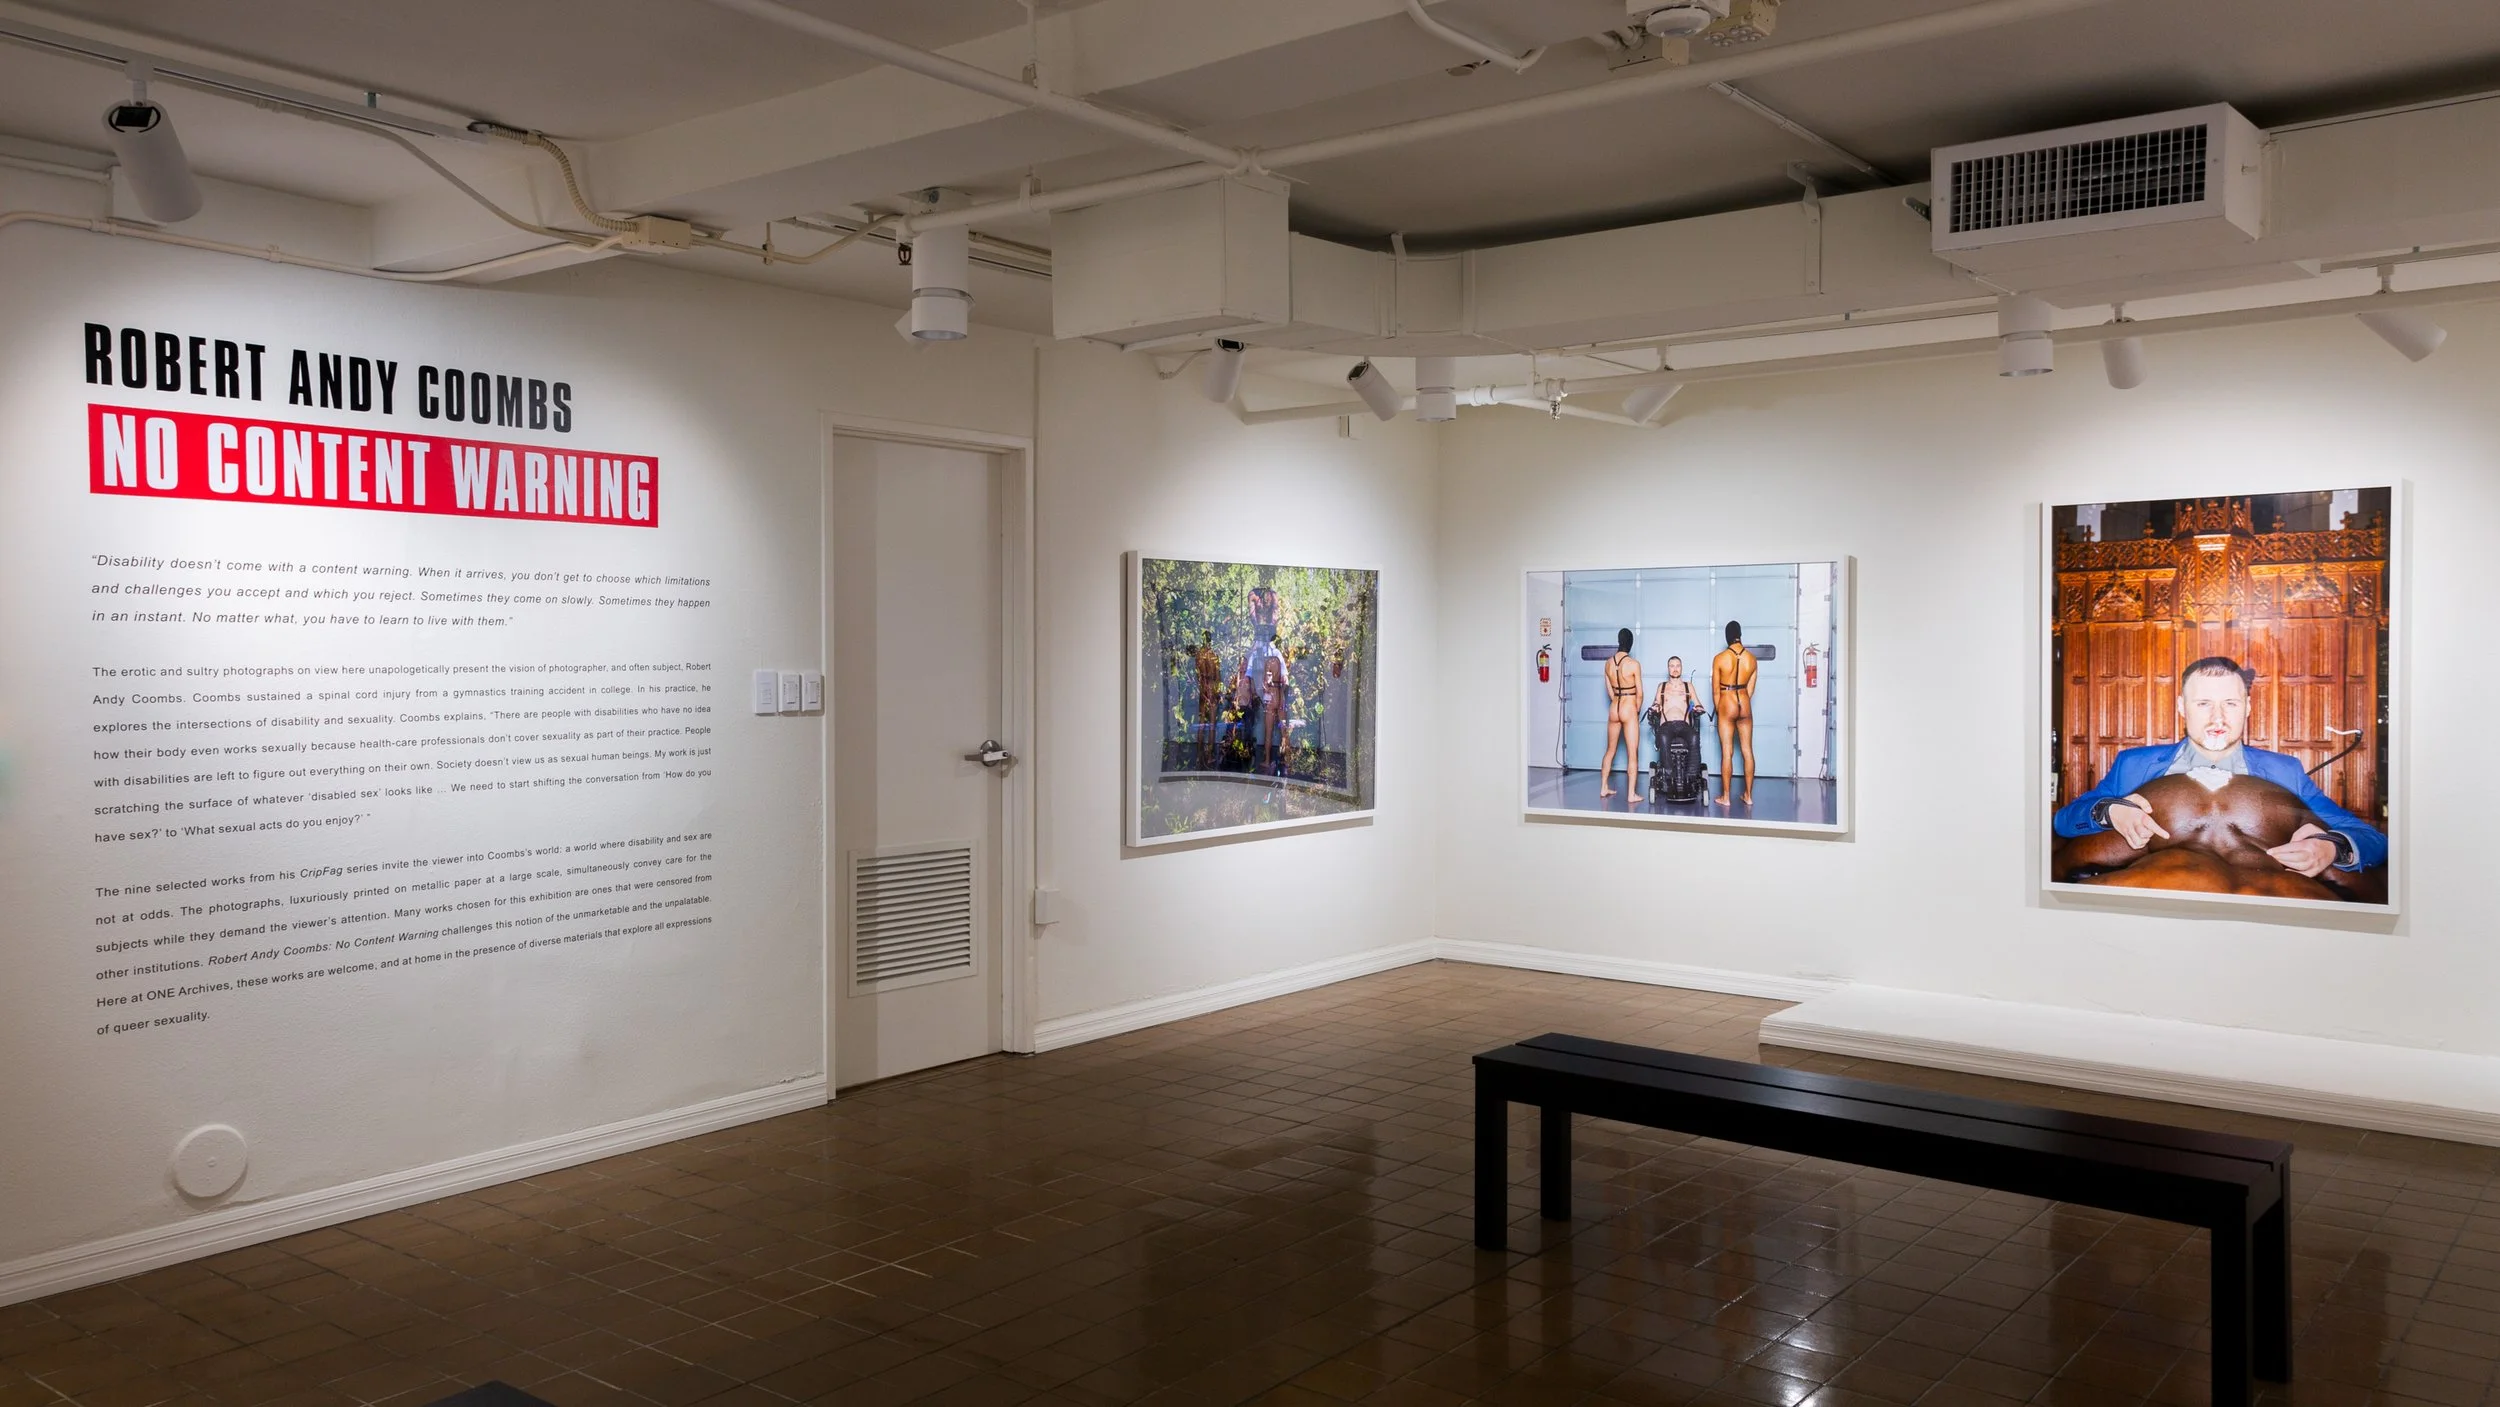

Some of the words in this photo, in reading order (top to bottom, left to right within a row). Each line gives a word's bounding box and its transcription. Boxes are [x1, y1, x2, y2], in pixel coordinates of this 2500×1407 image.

[85, 322, 266, 402] ROBERT
[288, 349, 399, 415] ANDY
[418, 365, 573, 433] COOMBS
[101, 413, 178, 490] NO
[207, 422, 431, 507] CONTENT
[451, 444, 651, 521] WARNING
[226, 562, 263, 572] come
[268, 561, 294, 573] with
[311, 564, 358, 575] content
[362, 566, 412, 579] warning.
[418, 566, 451, 578] When
[466, 569, 506, 581] arrives,
[596, 574, 631, 584] choose
[634, 575, 662, 585] which
[664, 576, 711, 587] limitations
[124, 583, 202, 599] challenges
[236, 587, 281, 600] accept
[313, 588, 349, 600] which
[379, 590, 415, 603] reject.
[420, 590, 483, 603] Sometimes
[561, 595, 594, 607] slowly.
[598, 595, 652, 607] Sometimes
[677, 598, 711, 609] happen
[134, 610, 186, 623] instant.
[216, 613, 260, 624] matter
[264, 613, 298, 625] what,
[330, 614, 360, 625] have
[379, 615, 409, 625] learn
[120, 667, 157, 677] erotic
[186, 666, 219, 679] sultry
[223, 666, 294, 678] photographs
[314, 665, 339, 675] view
[342, 665, 366, 675] here
[368, 664, 450, 676] unapologetically
[452, 665, 489, 675] present
[509, 665, 535, 673] vision
[548, 664, 609, 674] photographer,
[628, 663, 650, 672] often
[652, 663, 684, 673] subject,
[686, 662, 711, 671] Robert
[92, 694, 126, 707] Andy
[131, 693, 186, 704] Coombs.
[192, 692, 241, 703] Coombs
[246, 691, 301, 702] sustained
[318, 690, 350, 702] spinal
[355, 690, 378, 700] cord
[383, 690, 411, 701] injury
[415, 688, 438, 698] from
[452, 688, 507, 700] gymnastics
[510, 688, 545, 697] training
[548, 686, 585, 696] accident
[600, 686, 631, 696] college.
[664, 685, 698, 694] practice,
[93, 722, 148, 735] explores
[176, 718, 252, 730] intersections
[271, 716, 320, 728] disability
[347, 714, 396, 725] sexuality.
[399, 713, 441, 723] Coombs
[443, 712, 486, 723] explains,
[541, 709, 571, 720] people
[594, 707, 639, 717] disabilities
[124, 748, 153, 759] their
[156, 747, 187, 759] body
[190, 747, 220, 756] even
[223, 744, 258, 755] works
[261, 742, 307, 754] sexually
[311, 741, 356, 751] because
[360, 739, 418, 749] health-care
[420, 735, 485, 748] professionals
[514, 734, 539, 742] cover
[542, 731, 581, 742] sexuality
[626, 729, 646, 737] their
[648, 728, 682, 738] practice.
[685, 726, 711, 736] People
[93, 777, 120, 788] with
[123, 774, 190, 786] disabilities
[216, 771, 235, 781] left
[252, 769, 285, 781] figure
[309, 765, 365, 777] everything
[384, 762, 408, 772] their
[436, 760, 472, 770] Society
[560, 753, 589, 763] sexual
[591, 753, 620, 761] human
[622, 752, 652, 761] beings.
[94, 802, 160, 816] scratching
[188, 798, 233, 810] surface
[252, 795, 304, 805] whatever
[385, 787, 412, 797] looks
[509, 780, 530, 789] start
[533, 777, 565, 788] shifting
[585, 773, 639, 784] conversation
[94, 833, 126, 843] have
[218, 821, 256, 834] sexual
[259, 821, 283, 831] acts
[124, 884, 151, 895] nine
[156, 878, 207, 893] selected
[211, 875, 246, 887] works
[249, 873, 275, 883] from
[300, 866, 343, 879] CripFag
[346, 863, 379, 874] series
[382, 860, 410, 870] invite
[431, 856, 464, 866] viewer
[535, 846, 562, 856] world:
[573, 842, 597, 852] world
[599, 841, 626, 850] where
[628, 836, 664, 847] disability
[140, 909, 174, 921] odds.
[208, 898, 284, 916] photographs,
[290, 890, 349, 905] luxuriously
[353, 886, 390, 900] printed
[412, 880, 450, 892] metallic
[454, 878, 482, 889] paper
[509, 872, 532, 882] large
[536, 869, 563, 879] scale,
[566, 861, 630, 876] simultaneously
[633, 859, 662, 869] convey
[96, 939, 149, 953] subjects
[153, 934, 185, 946] while
[189, 932, 215, 942] they
[219, 924, 266, 939] demand
[340, 911, 390, 925] attention.
[394, 908, 422, 918] Many
[424, 904, 454, 915] works
[456, 900, 491, 911] chosen
[529, 890, 572, 902] exhibition
[656, 875, 693, 888] censored
[96, 969, 129, 981] other
[133, 960, 204, 976] institutions.
[208, 952, 248, 966] Robert
[250, 948, 280, 961] Andy
[283, 943, 332, 957] Coombs:
[354, 934, 395, 948] Content
[398, 930, 439, 942] Warning
[441, 923, 493, 937] challenges
[515, 917, 543, 927] notion
[572, 905, 630, 920] unmarketable
[664, 895, 711, 908] unpalatable.
[96, 996, 128, 1008] Here
[178, 982, 233, 997] Archives,
[236, 977, 269, 989] these
[271, 971, 304, 984] works
[327, 963, 378, 976] welcome,
[473, 943, 516, 958] presence
[529, 937, 562, 949] diverse
[563, 931, 603, 943] materials
[622, 925, 653, 936] explore
[666, 916, 712, 930] expressions
[113, 1020, 150, 1035] queer
[154, 1011, 210, 1027] sexuality.
